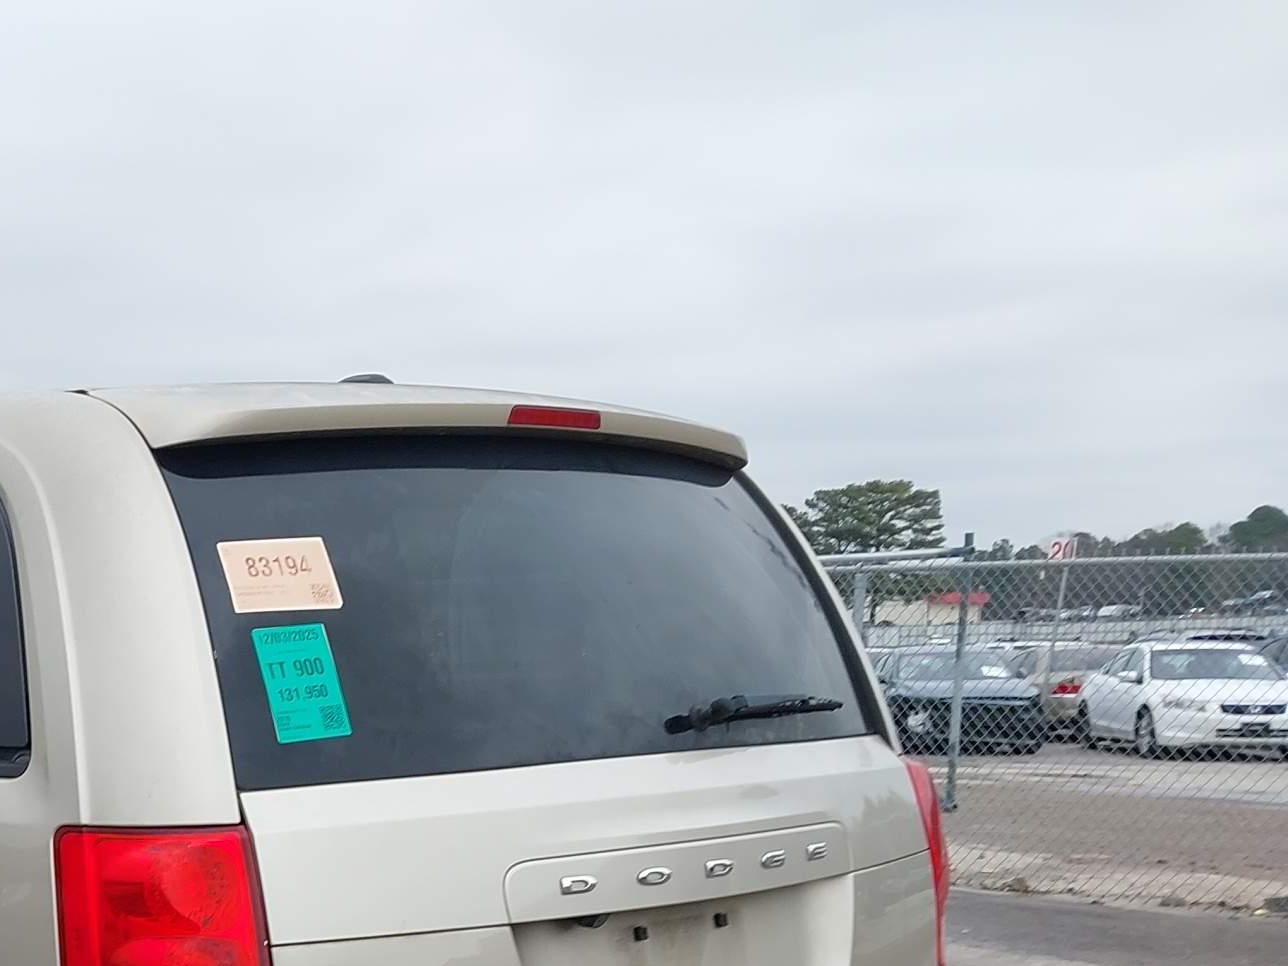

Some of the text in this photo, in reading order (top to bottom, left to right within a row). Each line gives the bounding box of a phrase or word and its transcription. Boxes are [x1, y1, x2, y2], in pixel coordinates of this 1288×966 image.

[244, 555, 312, 577] 83194
[266, 657, 325, 679] TT 900
[277, 684, 329, 702] 131,950
[560, 842, 827, 895] DODGE
